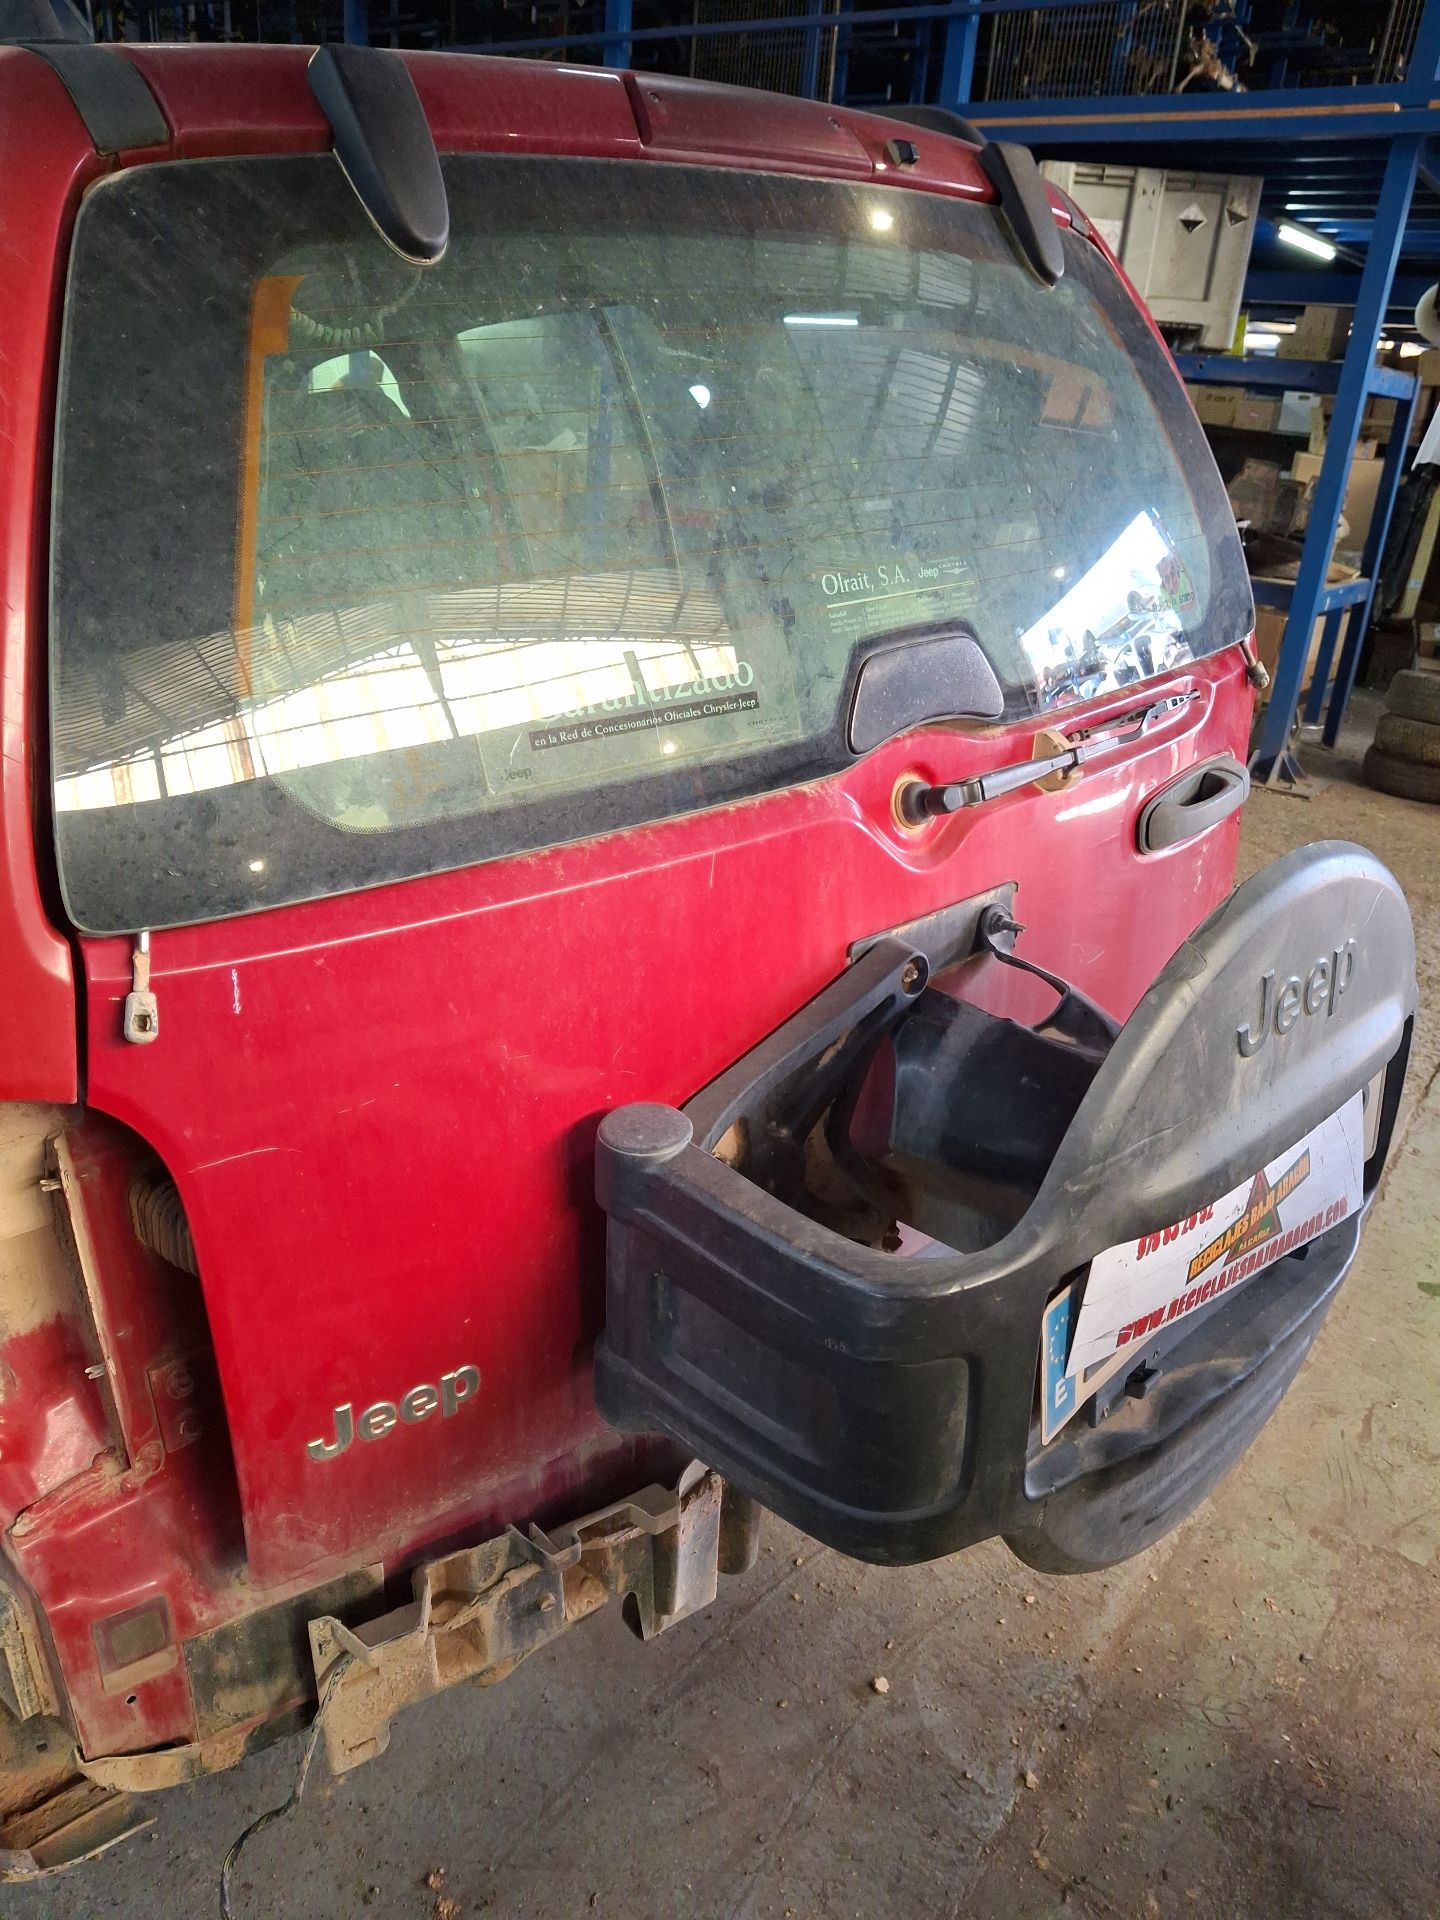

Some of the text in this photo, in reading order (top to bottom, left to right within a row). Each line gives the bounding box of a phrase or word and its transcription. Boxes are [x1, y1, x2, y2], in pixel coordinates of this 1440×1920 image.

[821, 564, 910, 595] Olrait, S.A.
[918, 565, 940, 579] Jeep
[534, 697, 756, 747] en la Red de Concesionarios Oficiales Chrysler-Jeep
[1236, 938, 1357, 1058] Jeep
[1190, 1213, 1249, 1277] RECICLAJES
[1250, 1190, 1275, 1226] BAJO
[1115, 1197, 1348, 1348] WWW.RECICLAJESBAJOARAGON.COM
[306, 1364, 481, 1462] Jeep
[1055, 1378, 1068, 1409] E
